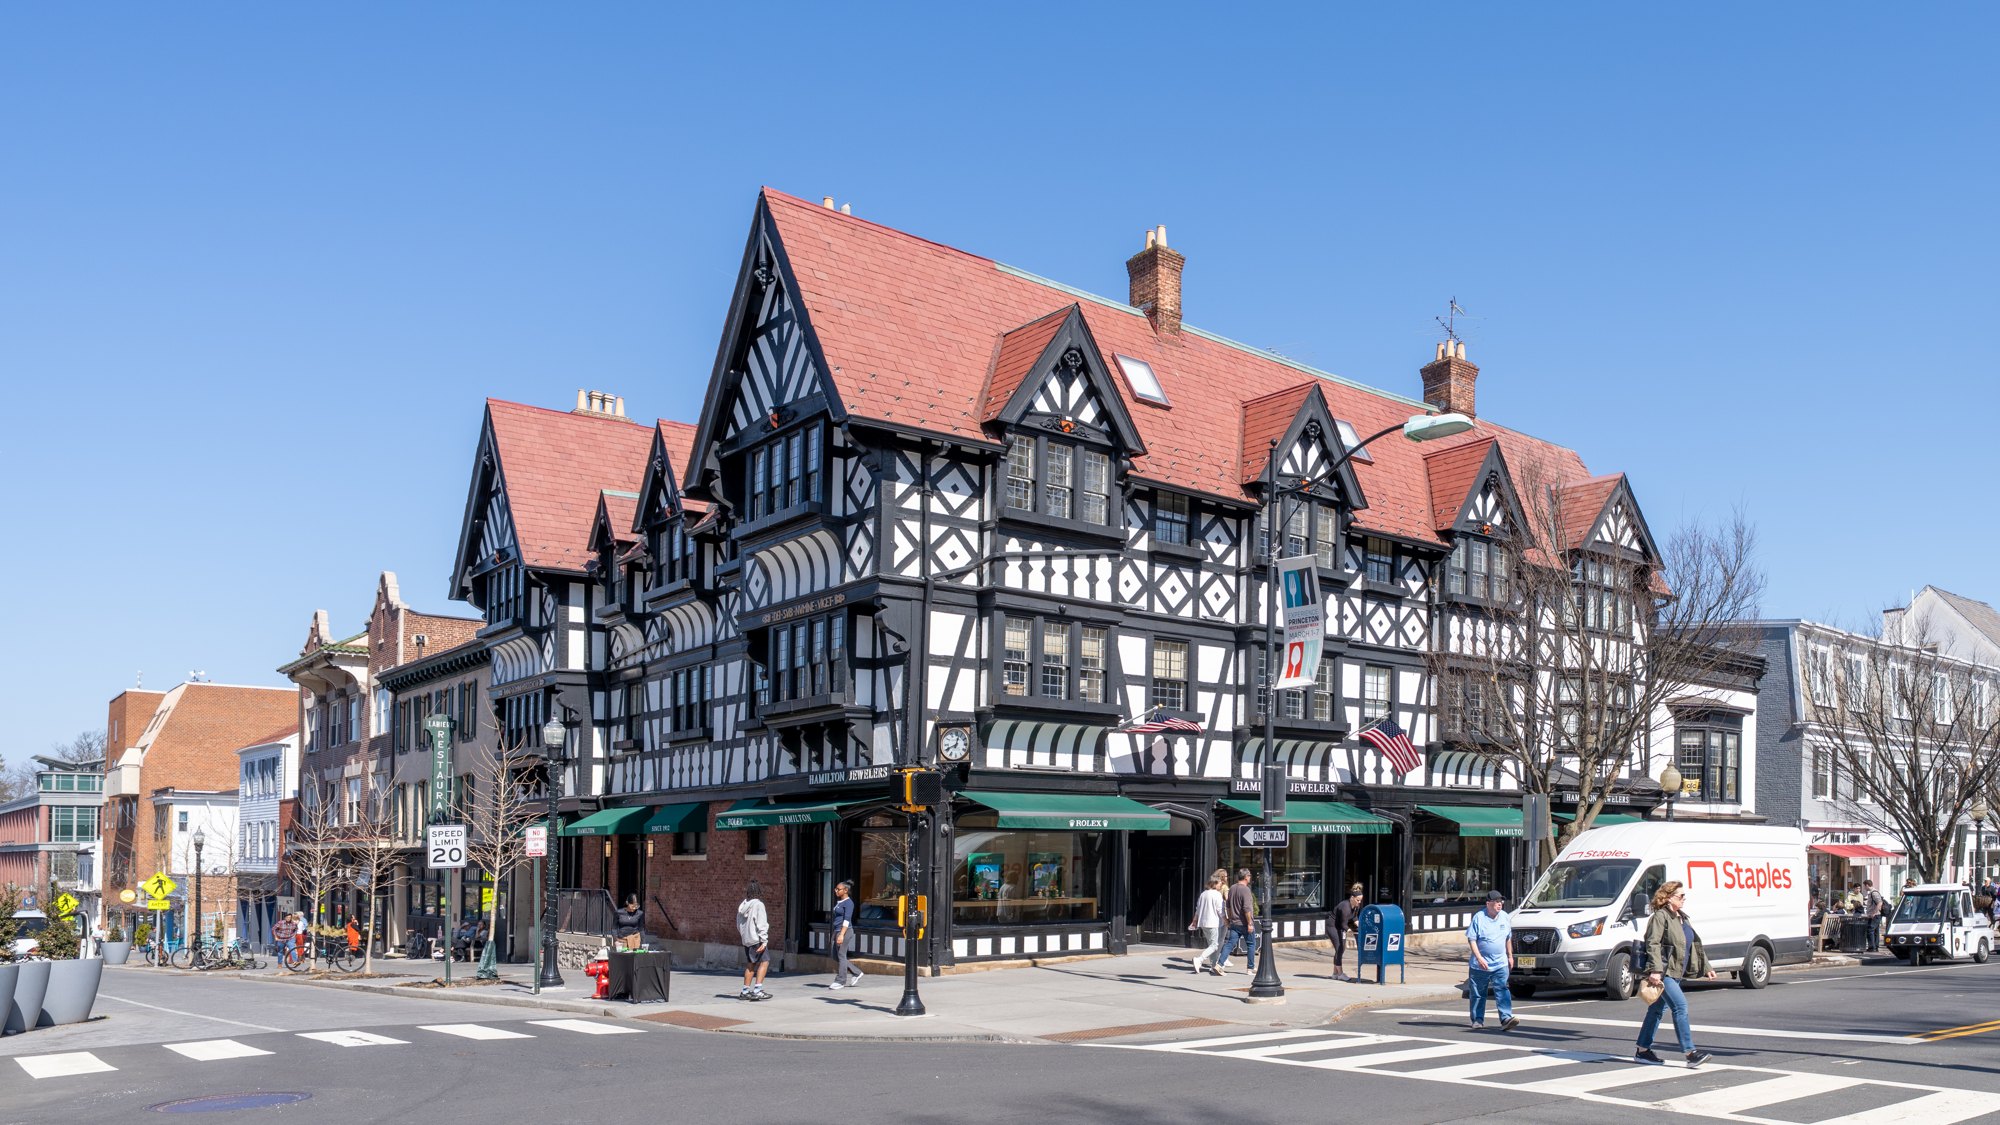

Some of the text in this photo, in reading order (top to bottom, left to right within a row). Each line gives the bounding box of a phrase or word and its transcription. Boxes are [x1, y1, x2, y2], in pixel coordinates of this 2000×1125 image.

[1288, 615, 1320, 625] PRINCETON
[1288, 630, 1310, 639] MARCH
[436, 730, 444, 824] RESTAURAN
[808, 766, 888, 785] HAMILTON JEWELERS
[1236, 781, 1336, 793] HAMI JEWELERS
[1565, 793, 1597, 802] HAMON
[779, 813, 812, 823] HAMILTON
[1075, 819, 1102, 827] ROLEX
[1311, 824, 1351, 833] HAMILTON
[431, 830, 463, 838] SPEED
[1253, 831, 1285, 841] ONE WAY
[432, 847, 463, 863] 20
[1583, 849, 1631, 858] Staples
[1722, 860, 1792, 897] Staples
